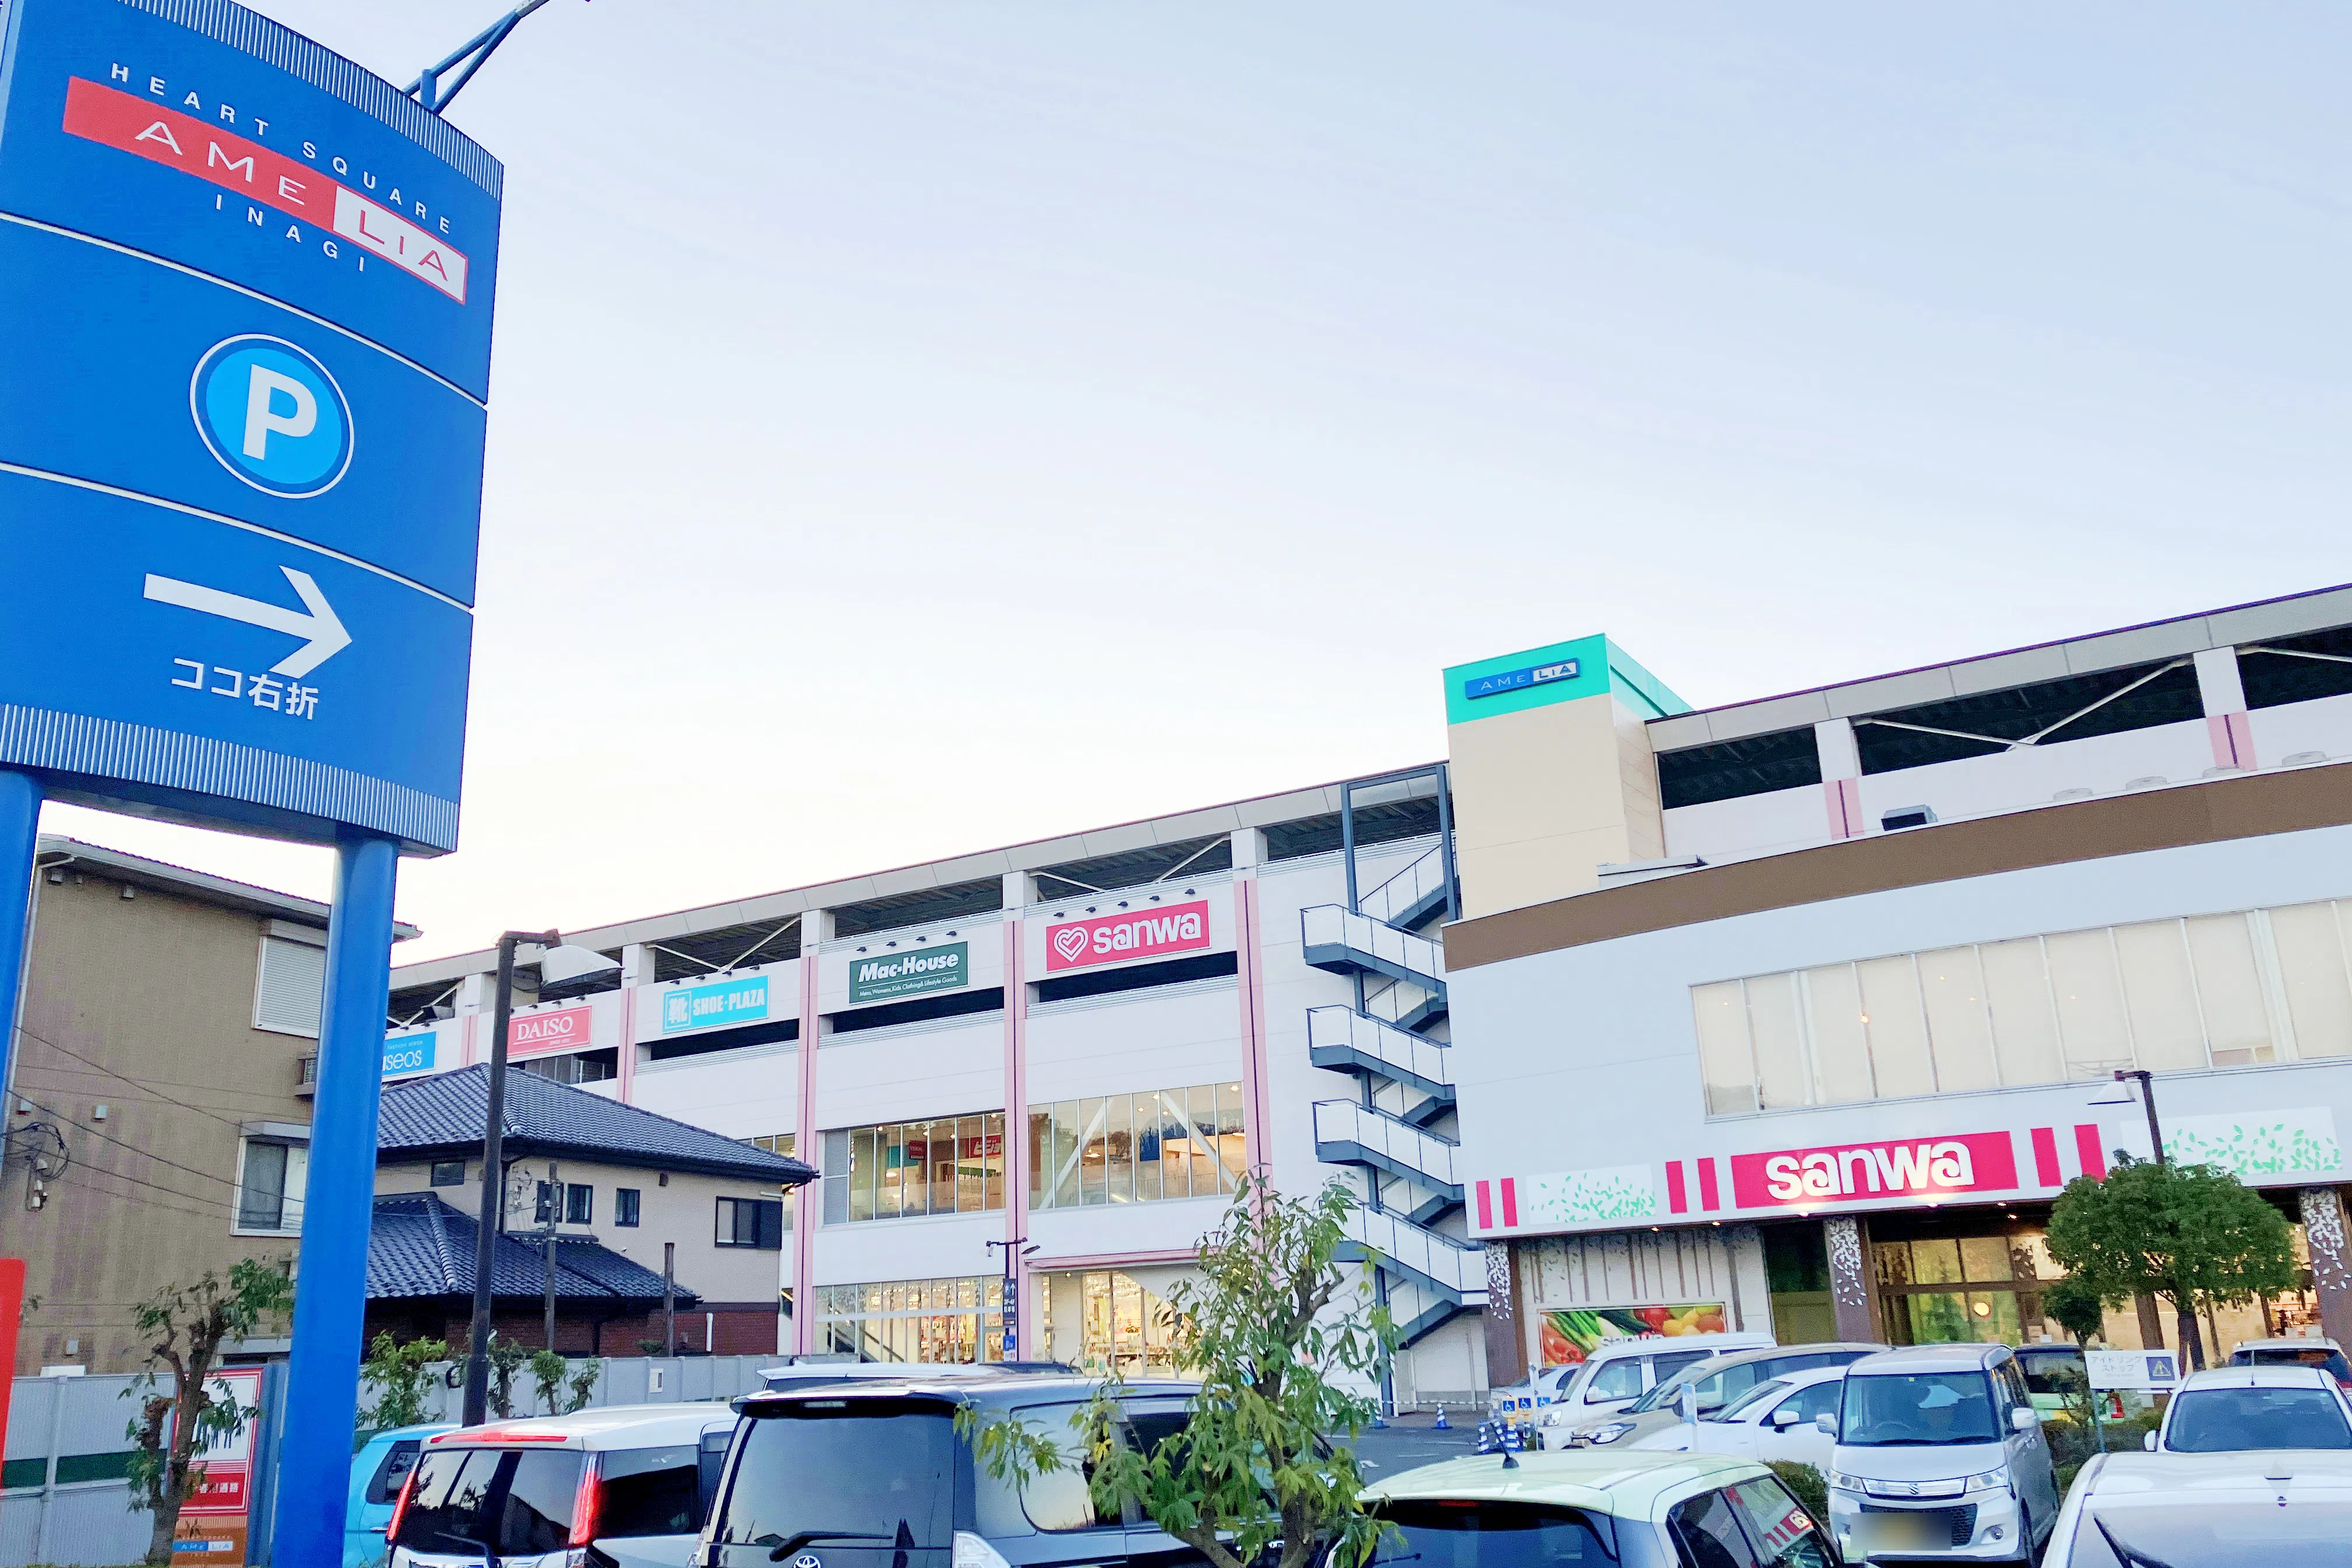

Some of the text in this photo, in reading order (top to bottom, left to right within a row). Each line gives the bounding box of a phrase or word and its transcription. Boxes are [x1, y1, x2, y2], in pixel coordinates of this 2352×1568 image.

[111, 63, 450, 235] HEART SQUARE
[216, 194, 365, 272] INAGI
[243, 364, 317, 460] P
[172, 657, 319, 720] ココ右折
[1093, 912, 1202, 955] sanwa
[858, 954, 959, 983] Mac-House
[942, 975, 957, 984] Goods
[516, 1016, 573, 1041] DAISO
[1765, 1142, 1975, 1200] sanwa
